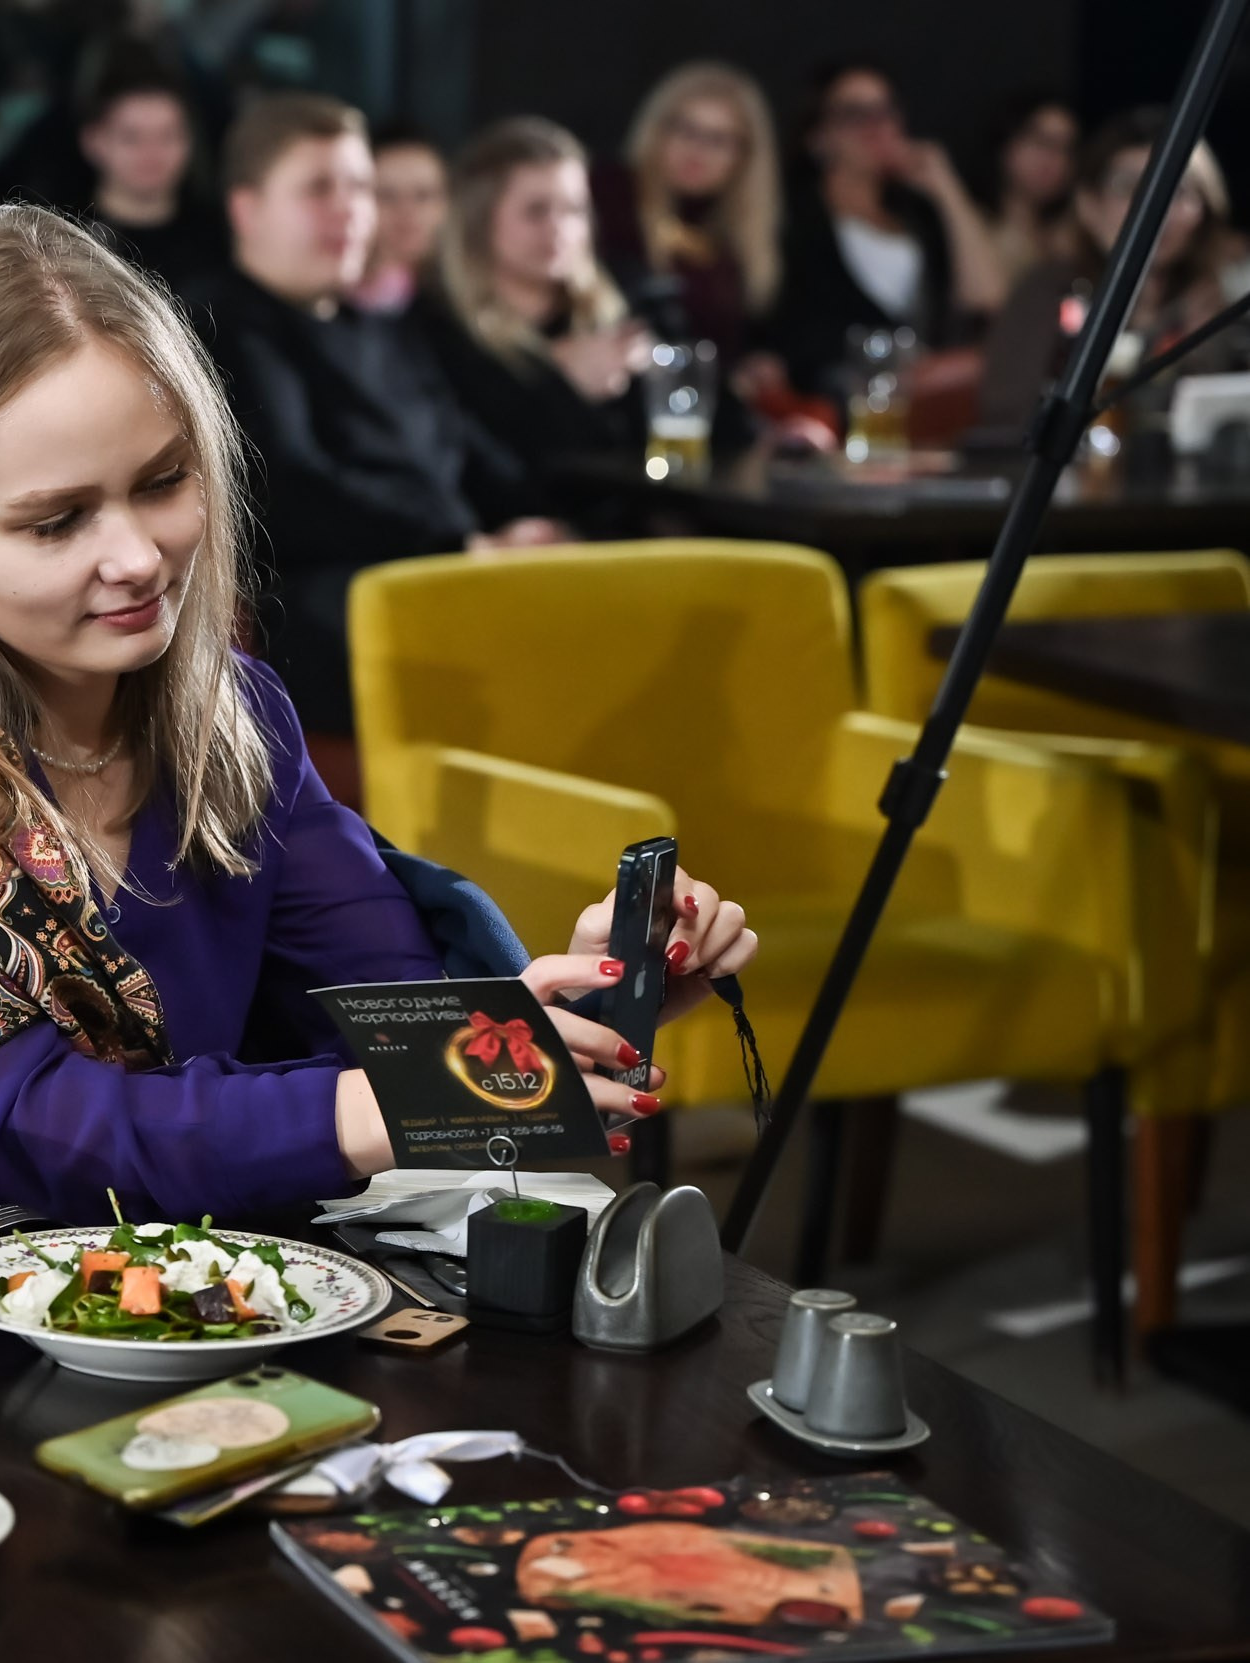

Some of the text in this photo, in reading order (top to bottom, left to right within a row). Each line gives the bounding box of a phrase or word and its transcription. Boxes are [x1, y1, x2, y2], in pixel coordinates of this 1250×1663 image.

[337, 996, 462, 1010] Новогодние
[349, 1010, 470, 1024] корпоративы
[490, 1072, 540, 1090] 15.12
